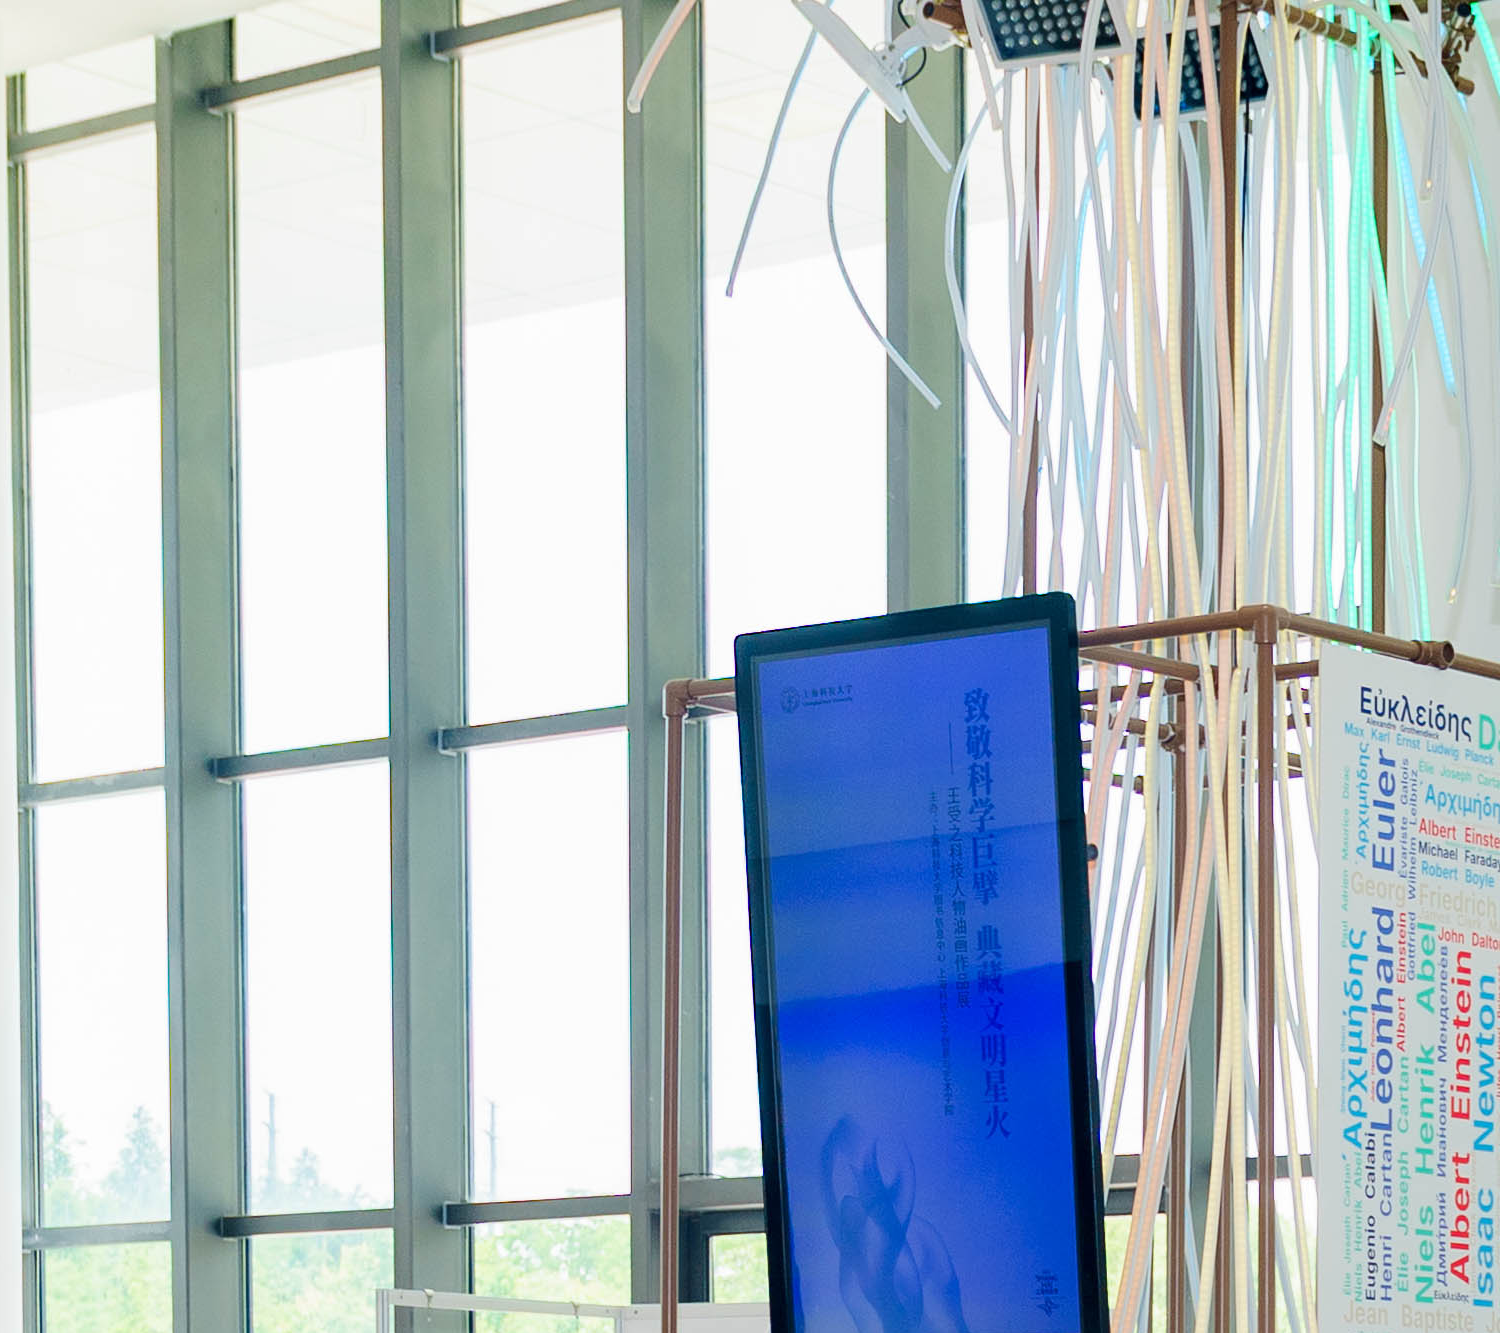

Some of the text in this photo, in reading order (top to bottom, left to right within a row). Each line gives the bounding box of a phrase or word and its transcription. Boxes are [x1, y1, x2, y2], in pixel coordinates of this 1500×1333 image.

[1344, 722, 1495, 766] Max Karl Ernst Ludwig Planck
[1400, 758, 1409, 805] Galois
[1407, 769, 1418, 981] Gottfried Wilhelm Leibniz
[1419, 817, 1456, 841] Albert
[1419, 841, 1458, 861] Michael
[1421, 860, 1495, 889] Robert Boyle
[964, 687, 1012, 1141] 致敬科学巨擘 典藏文明星火
[1351, 871, 1407, 908] Georg
[1419, 884, 1497, 919] Friedrich
[1370, 748, 1396, 1132] Leonhard Euler
[1438, 927, 1465, 945] John
[1395, 912, 1407, 1053] Albert Einstein
[1396, 1056, 1410, 1134] Cartan
[1414, 923, 1436, 1303] Niels Henrik Abel
[1450, 950, 1472, 1285] Albert Einstein
[1472, 975, 1495, 1308] Isaac Newton
[1353, 1152, 1363, 1302] Niels Henrik Abel
[1364, 1132, 1379, 1301] Eugenio Calabi
[1379, 1134, 1393, 1301] Henri Cartan
[1396, 1152, 1411, 1236] Joseph
[1343, 1300, 1389, 1327] Jean
